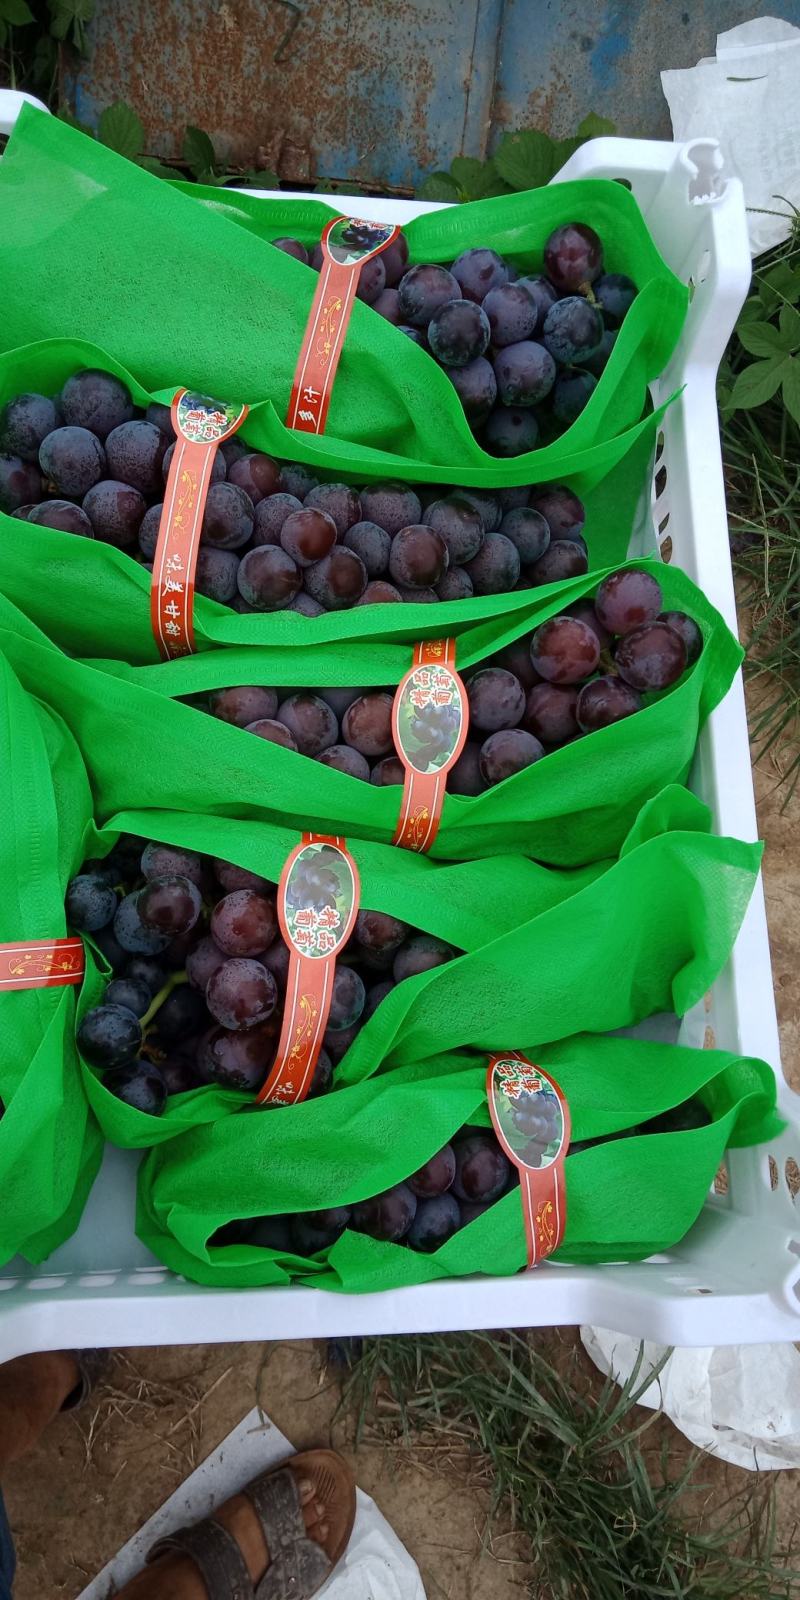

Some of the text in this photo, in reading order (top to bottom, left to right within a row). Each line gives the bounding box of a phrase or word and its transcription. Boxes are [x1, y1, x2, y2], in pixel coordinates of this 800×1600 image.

[410, 671, 431, 709] 精品
[431, 673, 453, 707] 葡萄
[293, 908, 318, 948] 葡萄
[317, 905, 340, 951] 精品
